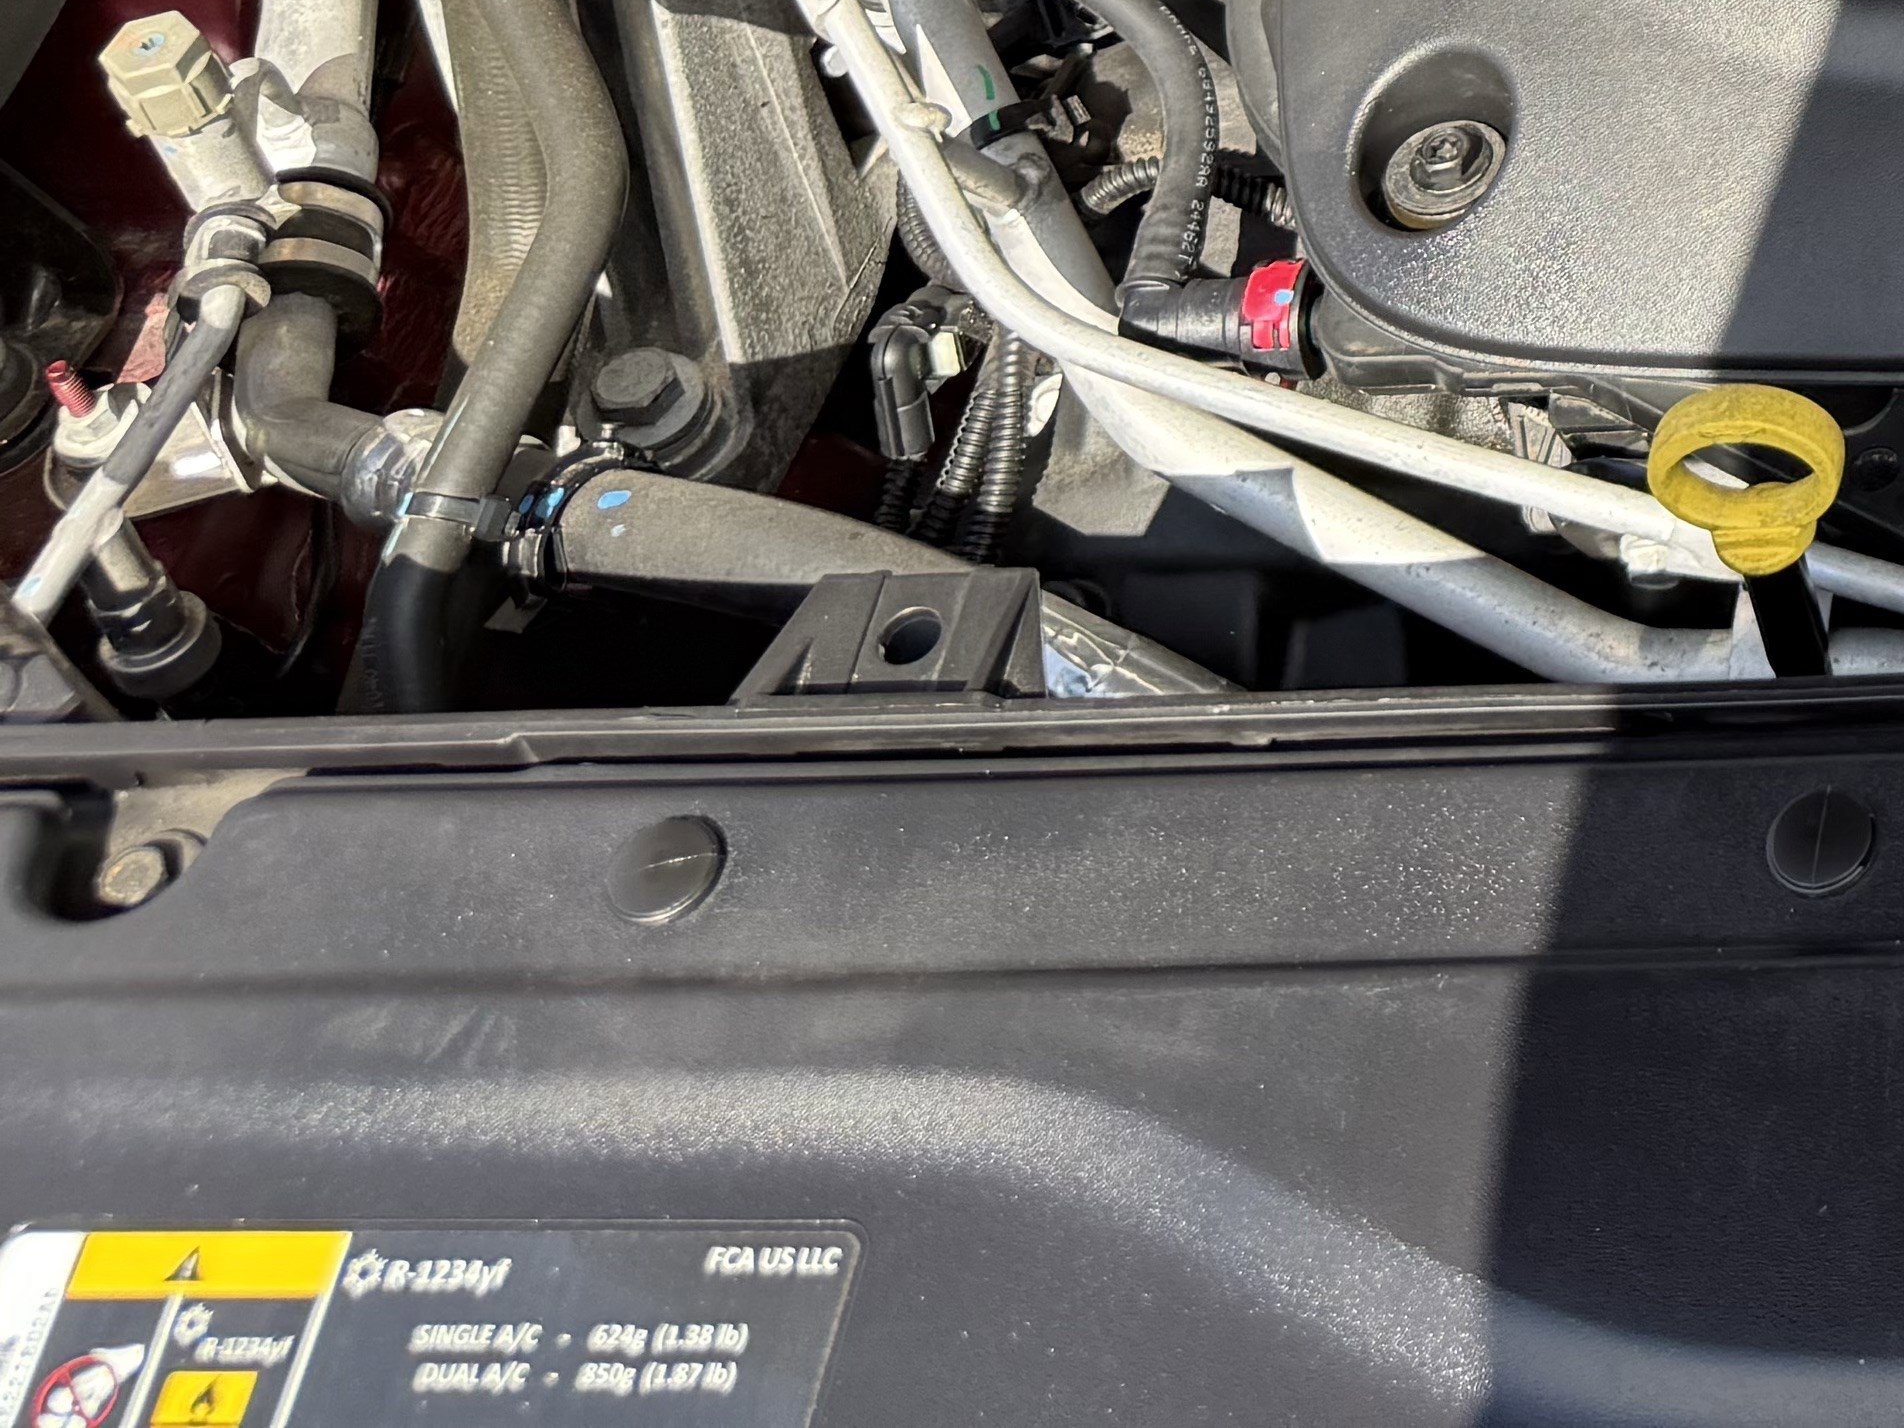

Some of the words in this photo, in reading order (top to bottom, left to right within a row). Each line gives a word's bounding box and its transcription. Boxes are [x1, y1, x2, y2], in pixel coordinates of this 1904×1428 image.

[382, 1258, 513, 1298] R-1234yf
[703, 1246, 755, 1276] FCA
[757, 1246, 797, 1276] US
[796, 1246, 843, 1276] LLC
[408, 1323, 496, 1353] SINGLE
[493, 1322, 543, 1356] A/C
[587, 1323, 649, 1359] 624g
[651, 1322, 715, 1357] (1.38
[713, 1322, 750, 1357] lb)
[412, 1362, 480, 1393] DUAL
[479, 1360, 531, 1395] A/C
[574, 1361, 637, 1398] 850g
[638, 1361, 704, 1397] (1.87
[700, 1361, 738, 1397] lb)
